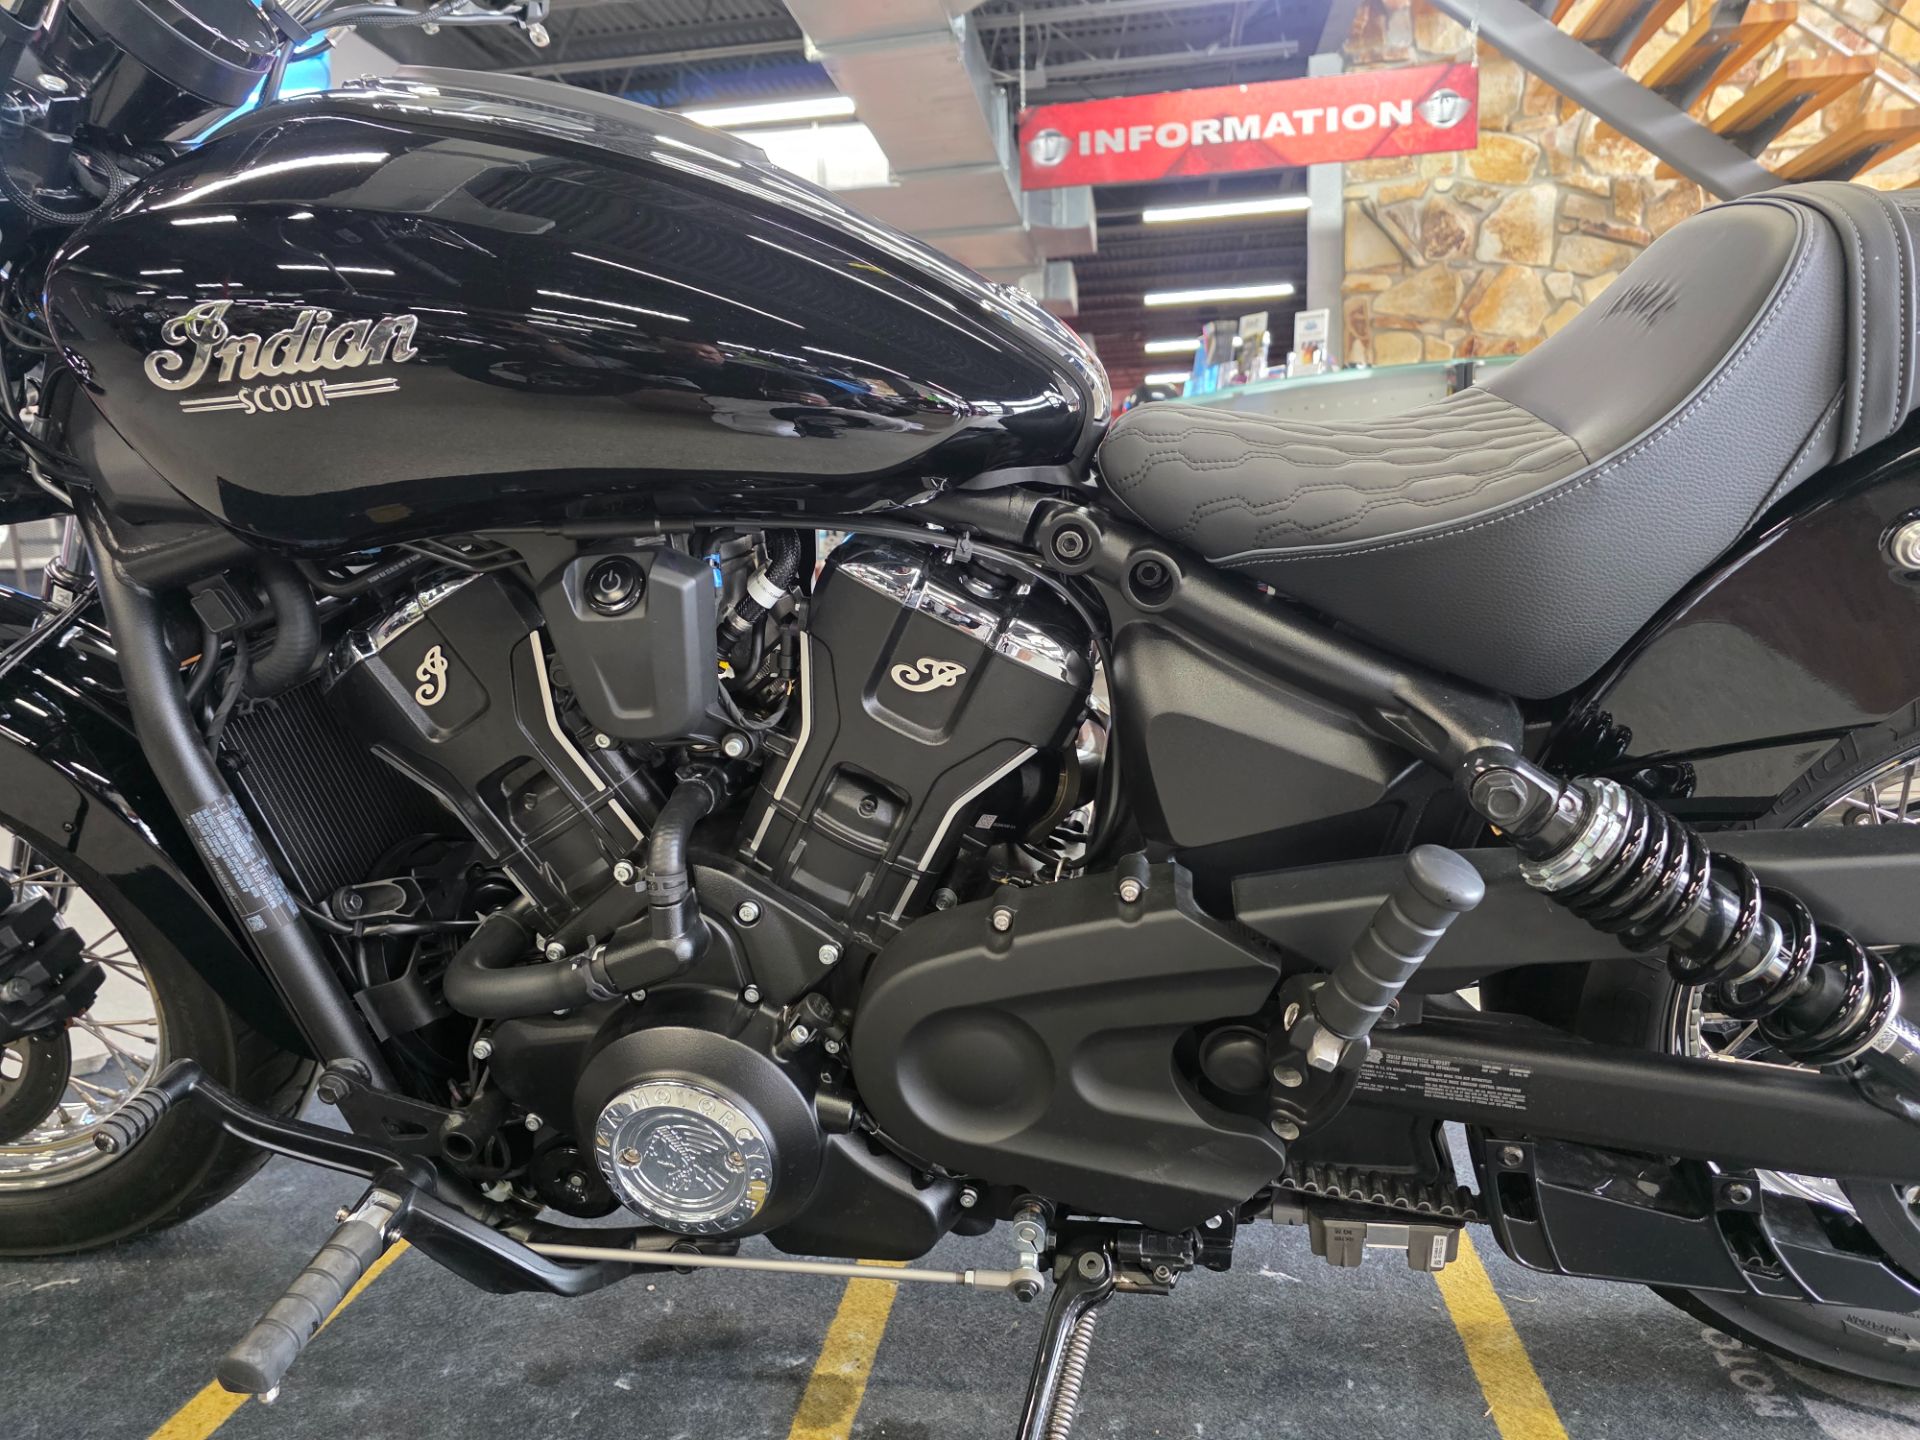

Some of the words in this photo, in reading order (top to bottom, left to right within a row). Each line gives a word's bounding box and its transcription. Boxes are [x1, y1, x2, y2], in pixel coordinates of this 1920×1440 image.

[1079, 99, 1413, 156] INFORMATION
[144, 300, 418, 390] Indian
[237, 379, 329, 414] SCOUT
